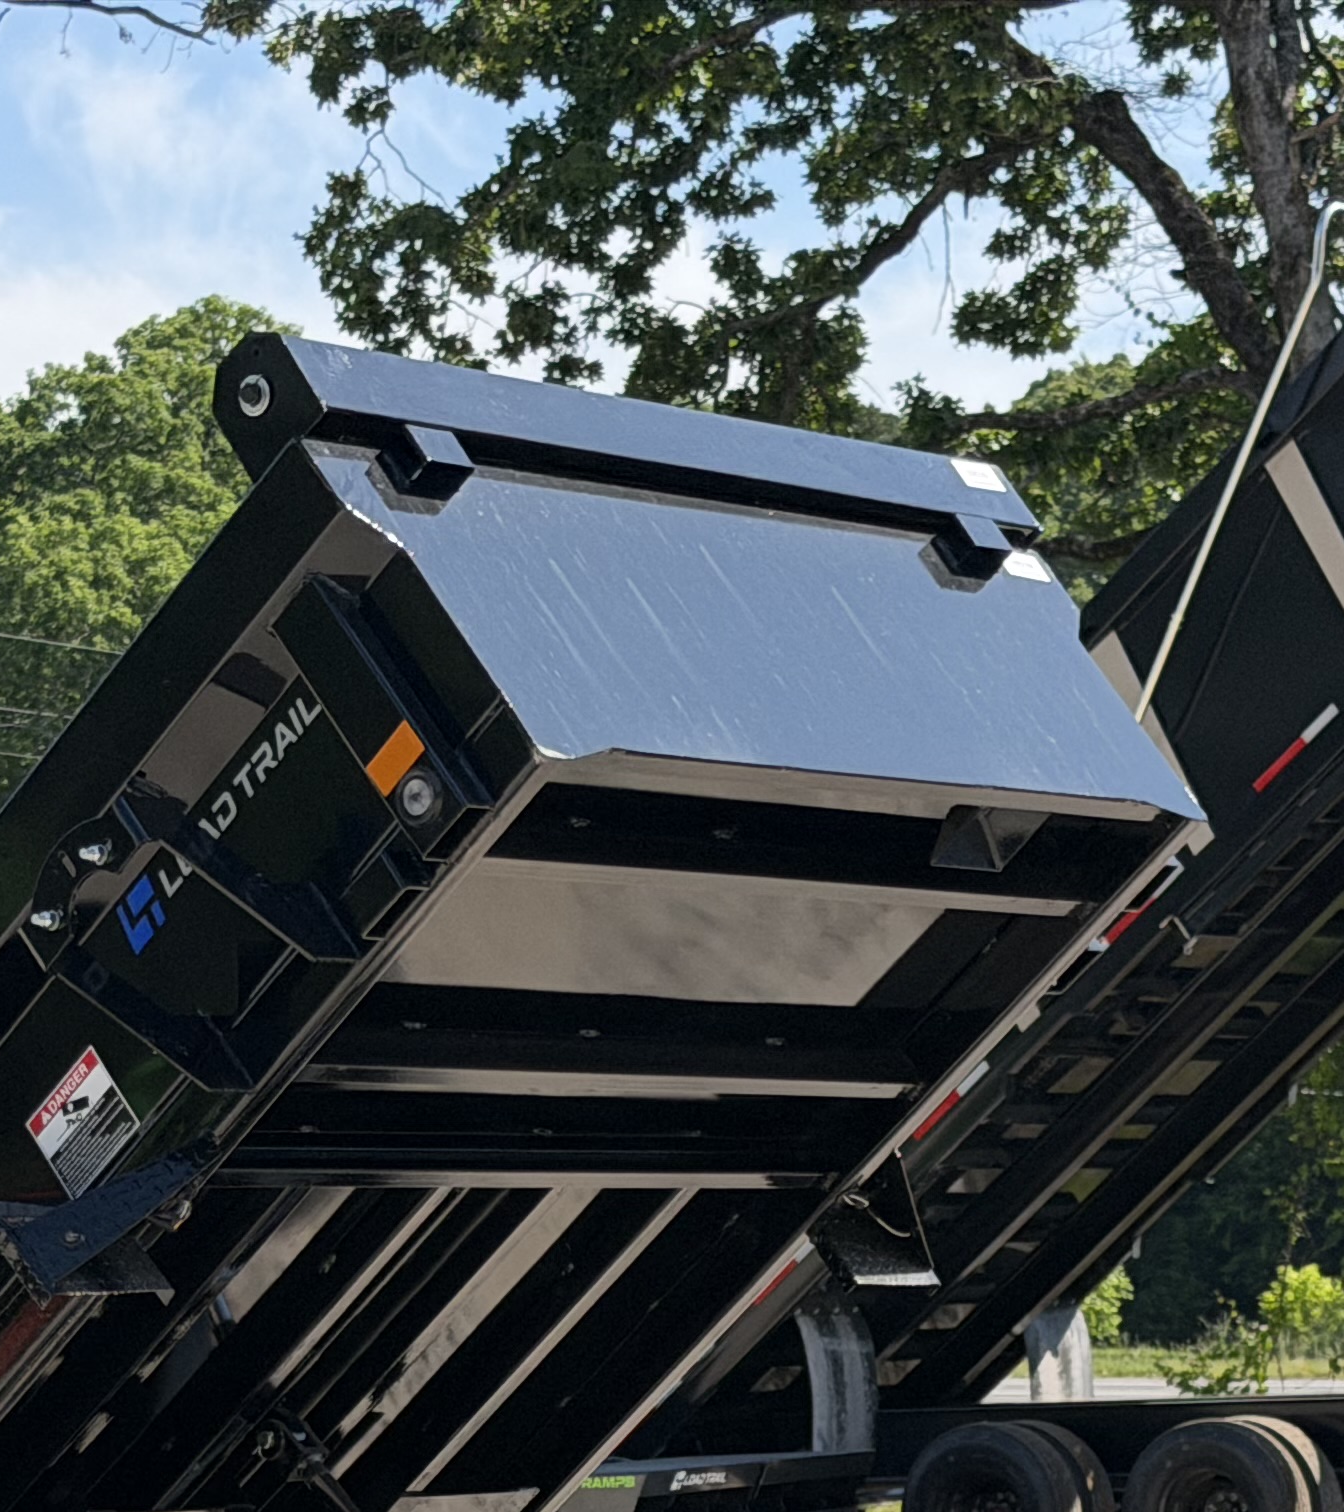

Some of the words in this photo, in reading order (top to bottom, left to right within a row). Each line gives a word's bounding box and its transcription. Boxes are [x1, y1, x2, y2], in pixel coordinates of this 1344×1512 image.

[233, 697, 323, 799] TRAIL
[50, 1062, 89, 1114] DANGER
[581, 1475, 636, 1489] RAMPS
